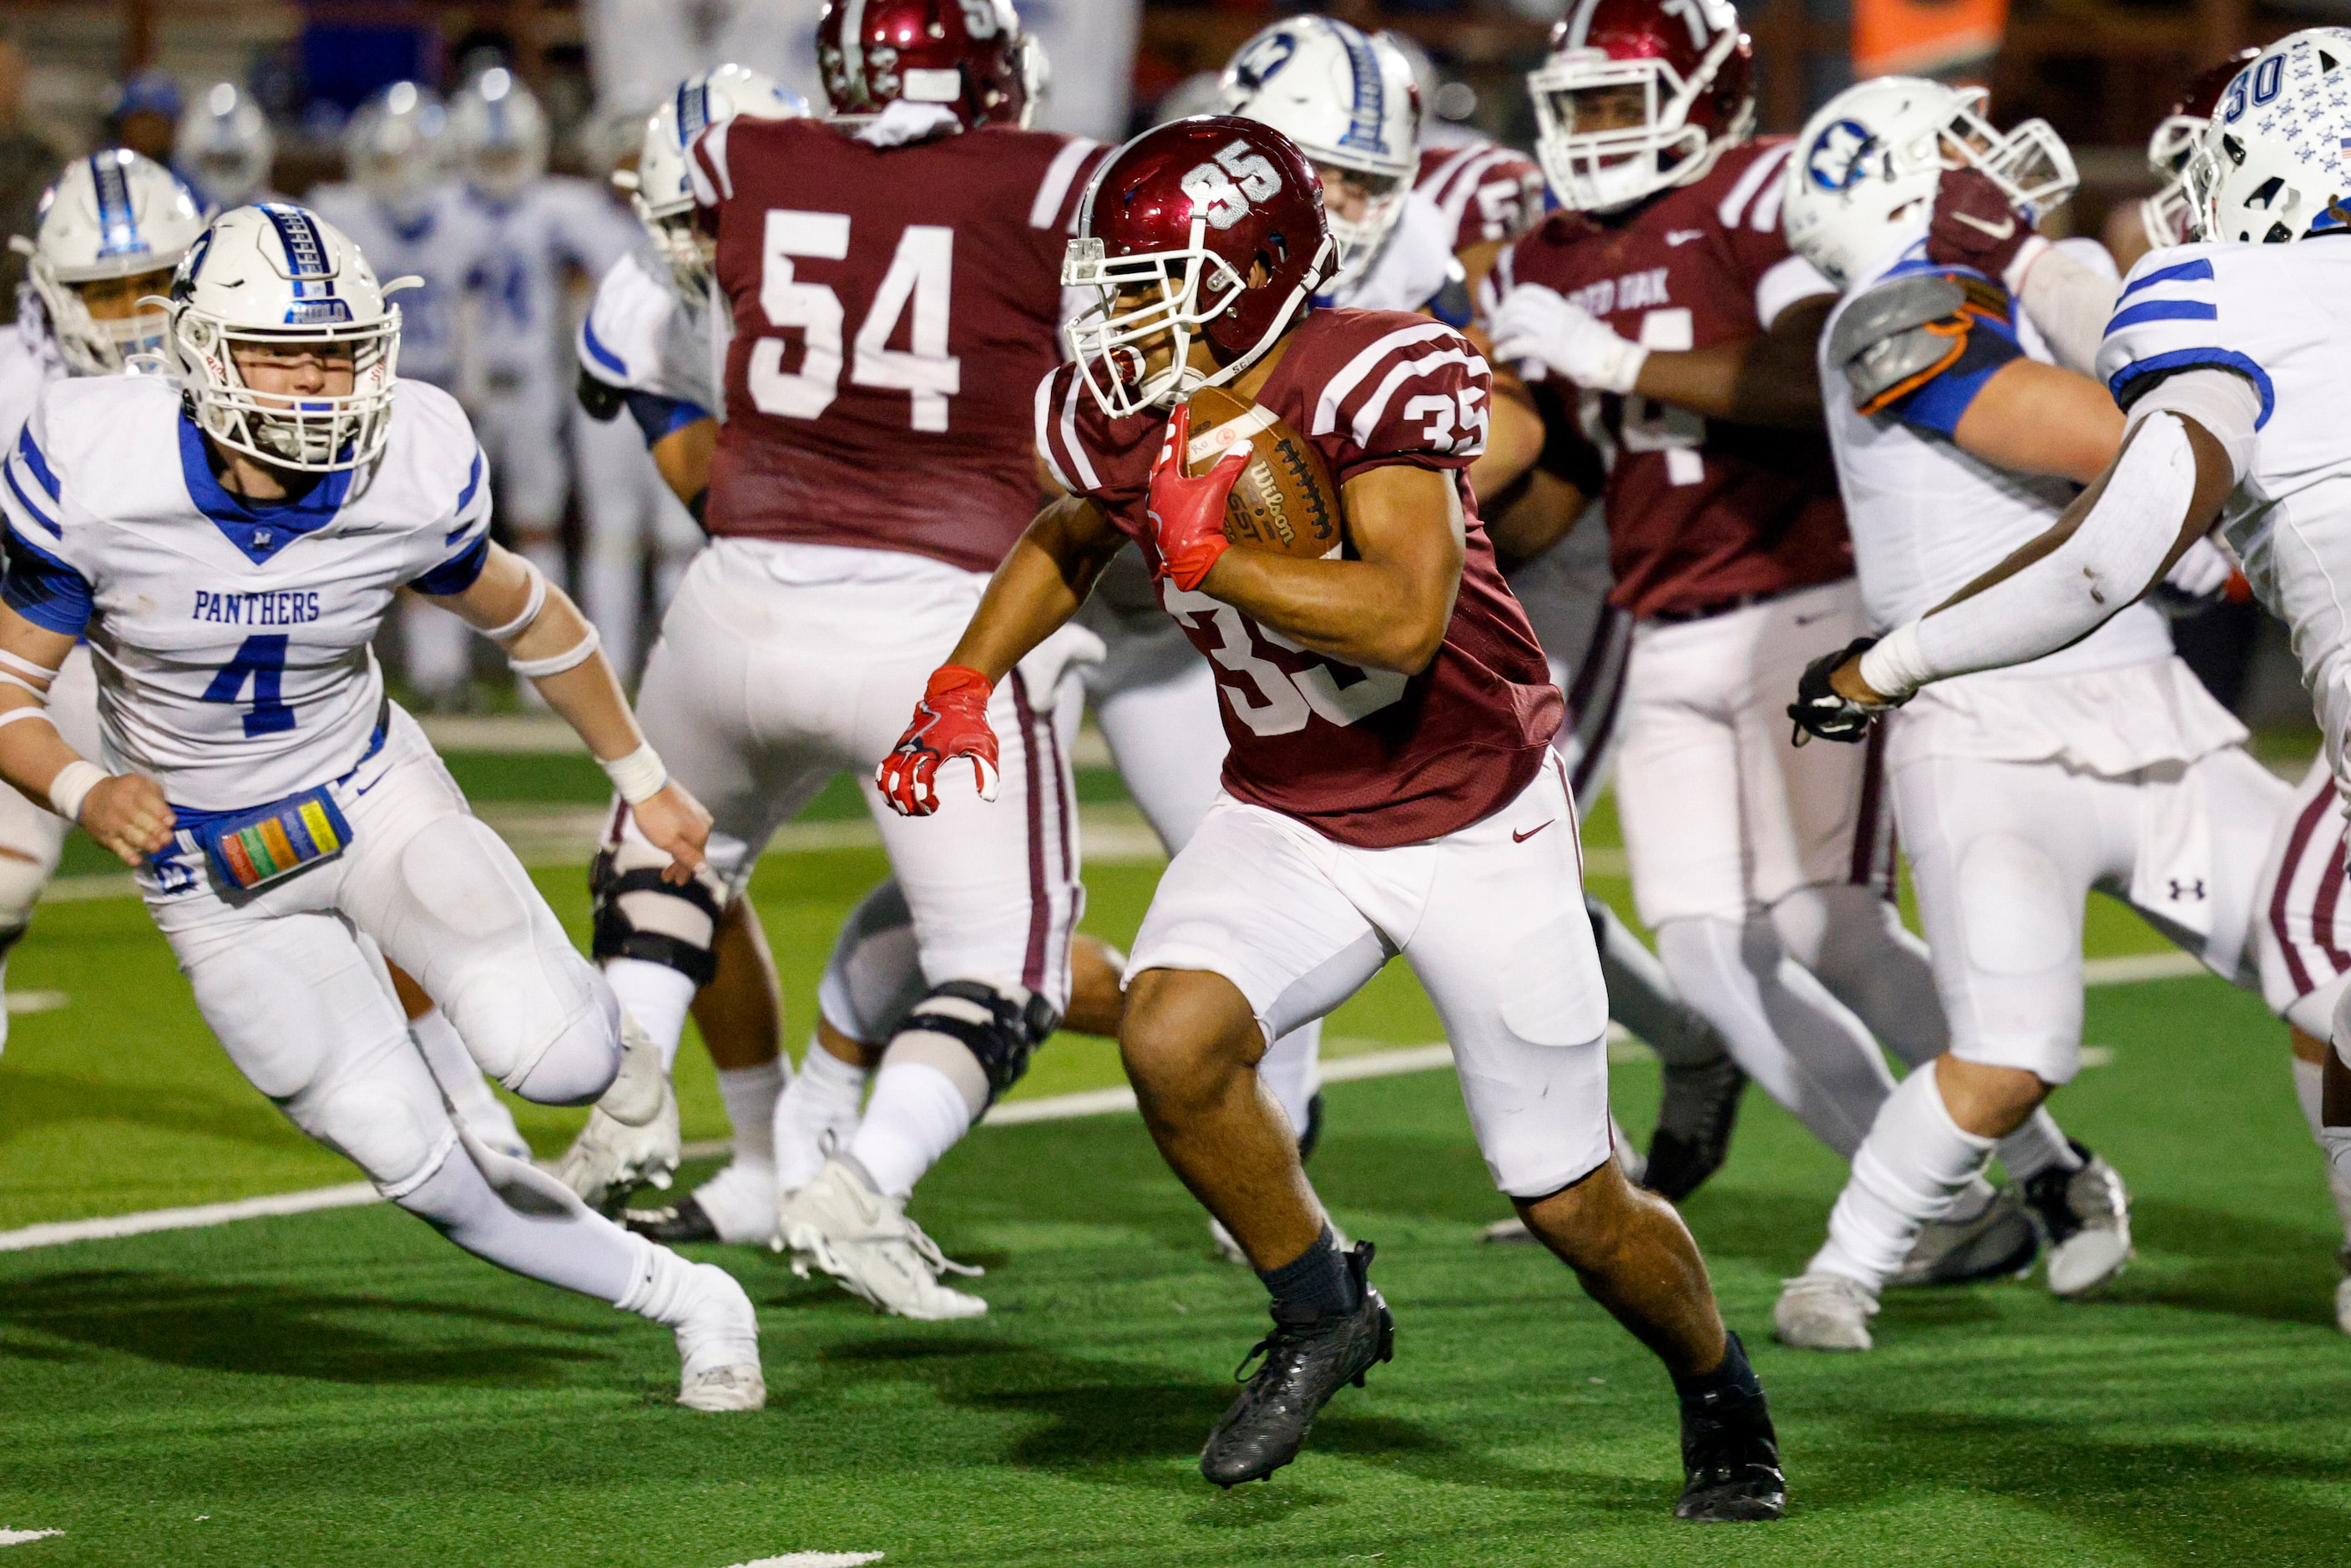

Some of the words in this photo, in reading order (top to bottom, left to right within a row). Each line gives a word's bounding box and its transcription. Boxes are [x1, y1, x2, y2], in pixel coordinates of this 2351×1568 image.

[1180, 138, 1282, 230] 35
[747, 209, 961, 432] 54
[1403, 386, 1490, 457] 35
[1251, 459, 1296, 548] Wilson
[192, 589, 320, 625] PANTHERS
[200, 633, 296, 739] 4
